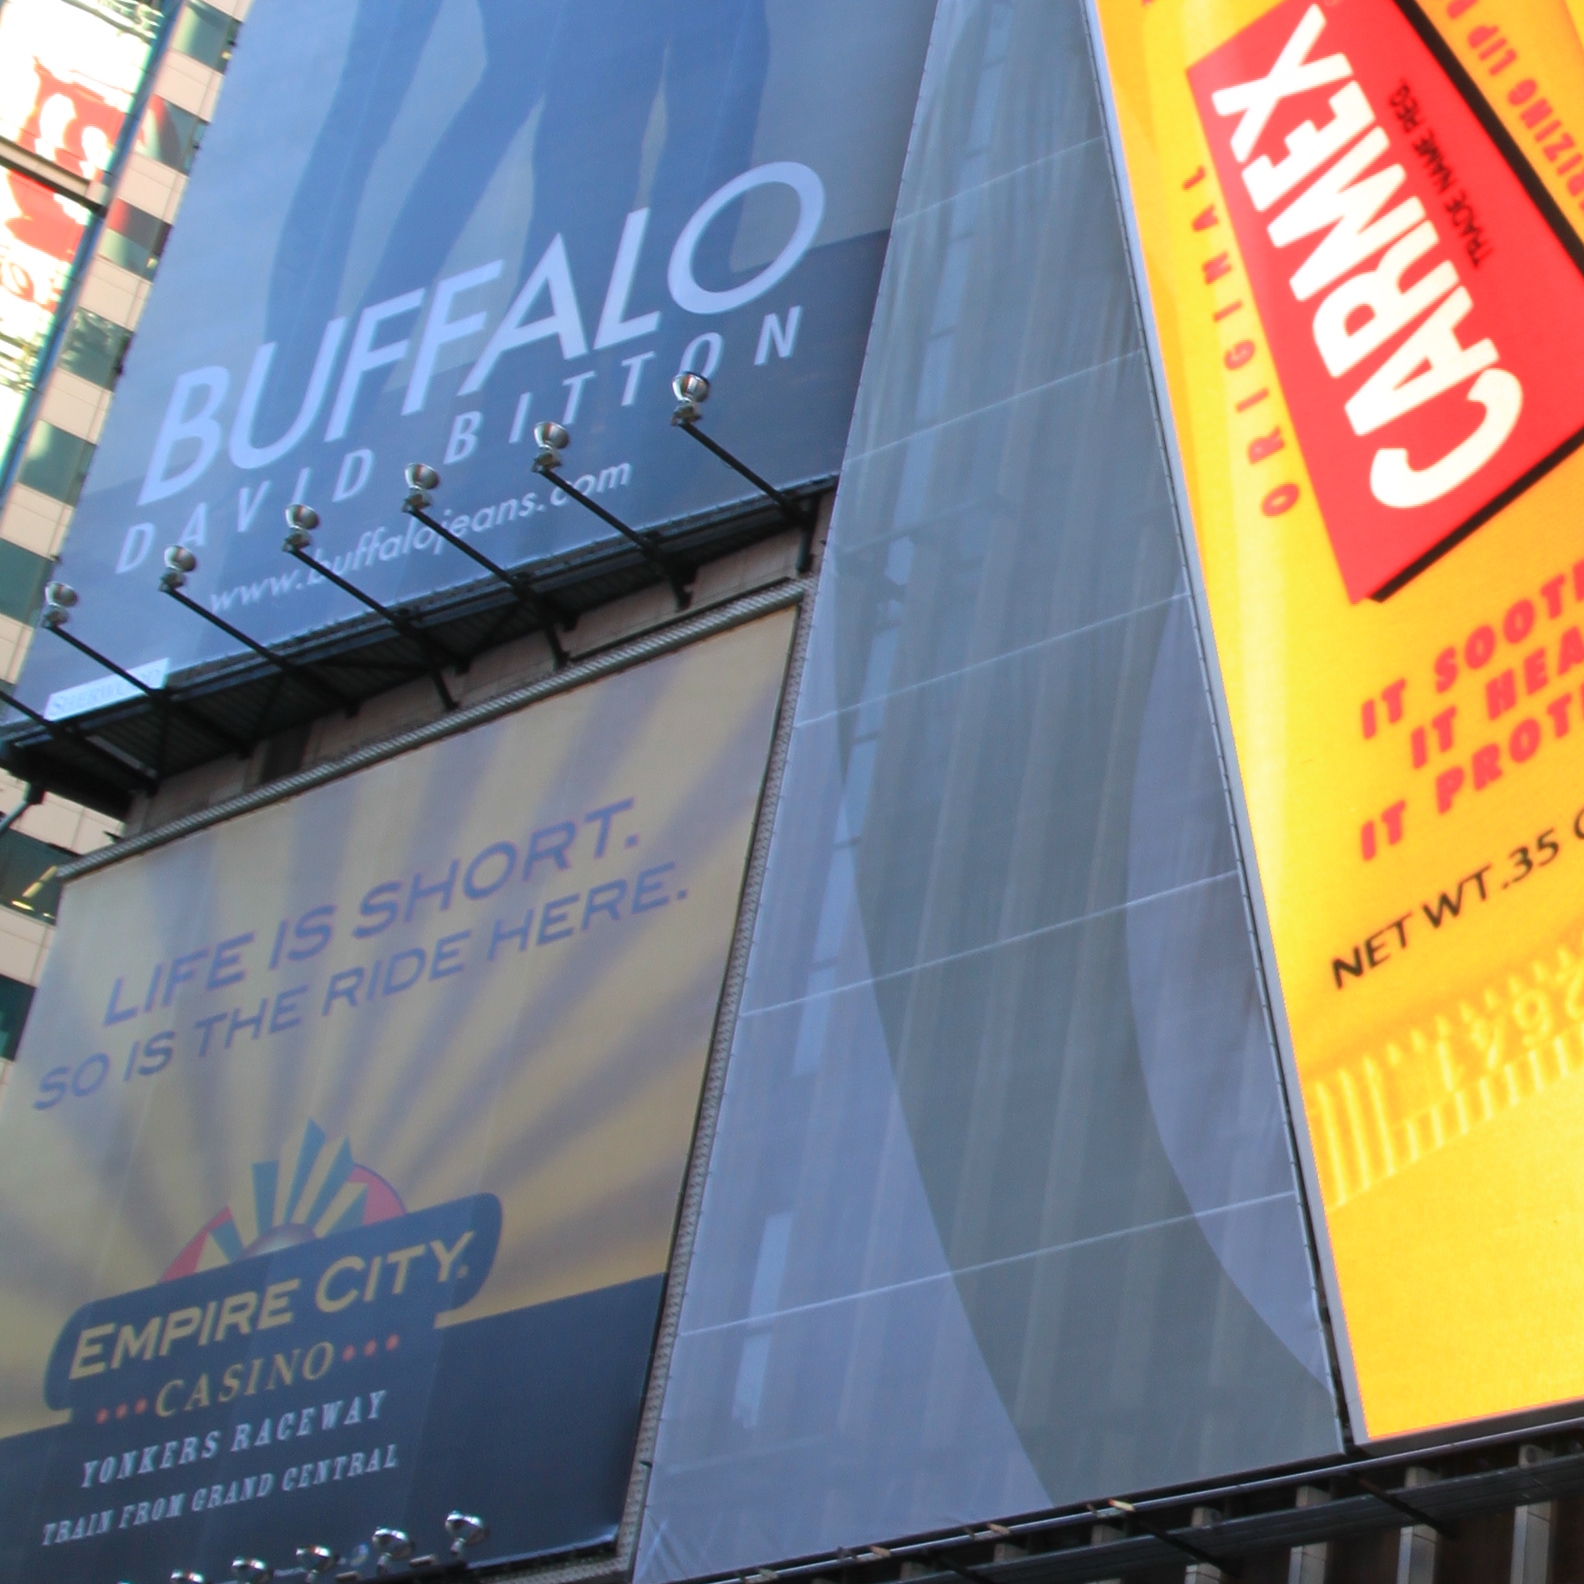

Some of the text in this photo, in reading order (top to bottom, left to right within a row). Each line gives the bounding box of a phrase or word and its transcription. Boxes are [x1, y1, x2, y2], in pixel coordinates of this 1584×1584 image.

[1467, 24, 1518, 76] LIP
[1210, 1, 1524, 512] CARMEX
[137, 161, 826, 507] BUFFALO
[1181, 163, 1302, 519] ORIGINAL
[116, 305, 803, 575] DAVID BITTON
[210, 460, 632, 614] www.buffalojeans.com
[1360, 676, 1407, 741] IT
[1410, 705, 1458, 770] IT
[1360, 798, 1407, 863] IT
[102, 798, 641, 1029] LIFE IS SHORT.
[1330, 910, 1415, 991] NET
[32, 861, 691, 1111] SO IS THE RIDE HERE.
[69, 1276, 302, 1380] EMPIRE
[154, 1340, 335, 1418] CASINO
[81, 1389, 387, 1489] YONKERS RACEWAY
[42, 1443, 400, 1546] TRAIN FROM GRAND CENTRAL
